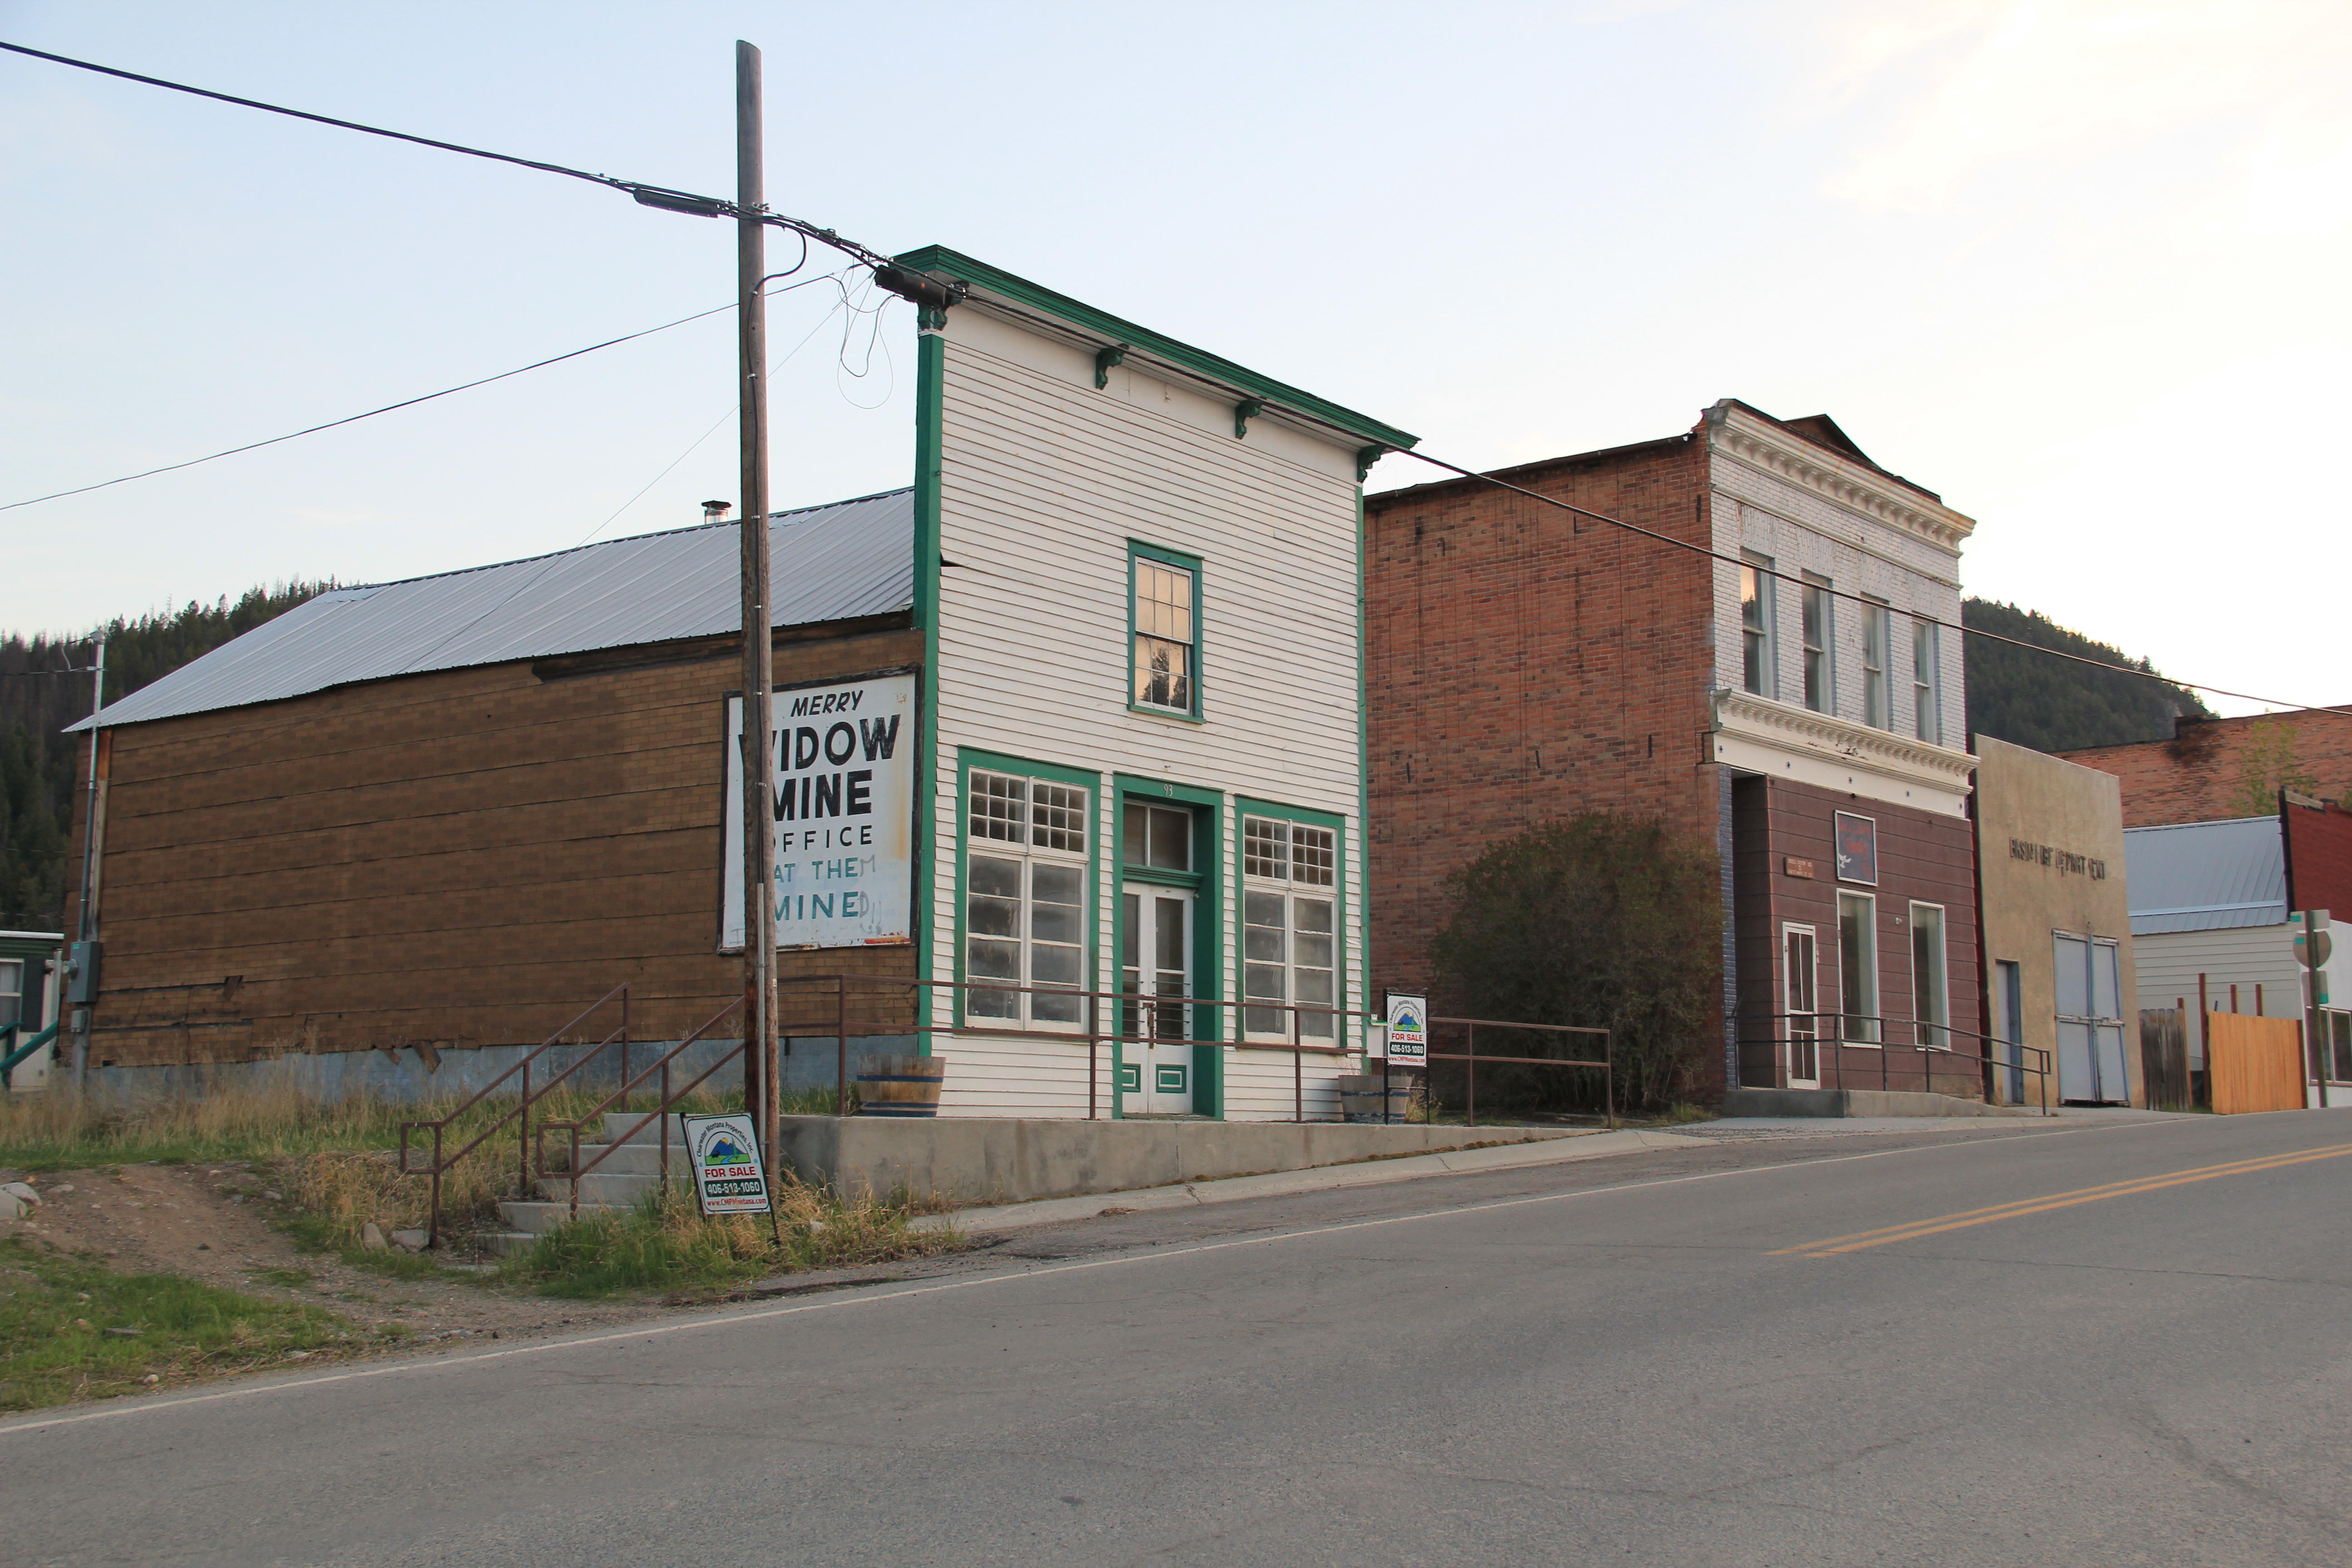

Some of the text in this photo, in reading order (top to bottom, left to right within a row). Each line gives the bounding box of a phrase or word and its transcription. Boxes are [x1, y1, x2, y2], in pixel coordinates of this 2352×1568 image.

[791, 690, 863, 717] MERRY
[1164, 784, 1173, 797] 93
[774, 825, 872, 853] FFICE
[774, 863, 796, 883] AT
[1391, 1044, 1424, 1054] 406-513-1060
[696, 1130, 707, 1156] Clearwater
[706, 1122, 725, 1132] Montana
[725, 1122, 747, 1143] Properties,
[705, 1166, 756, 1178] FOR SALE
[707, 1181, 760, 1194] 406-513-1060
